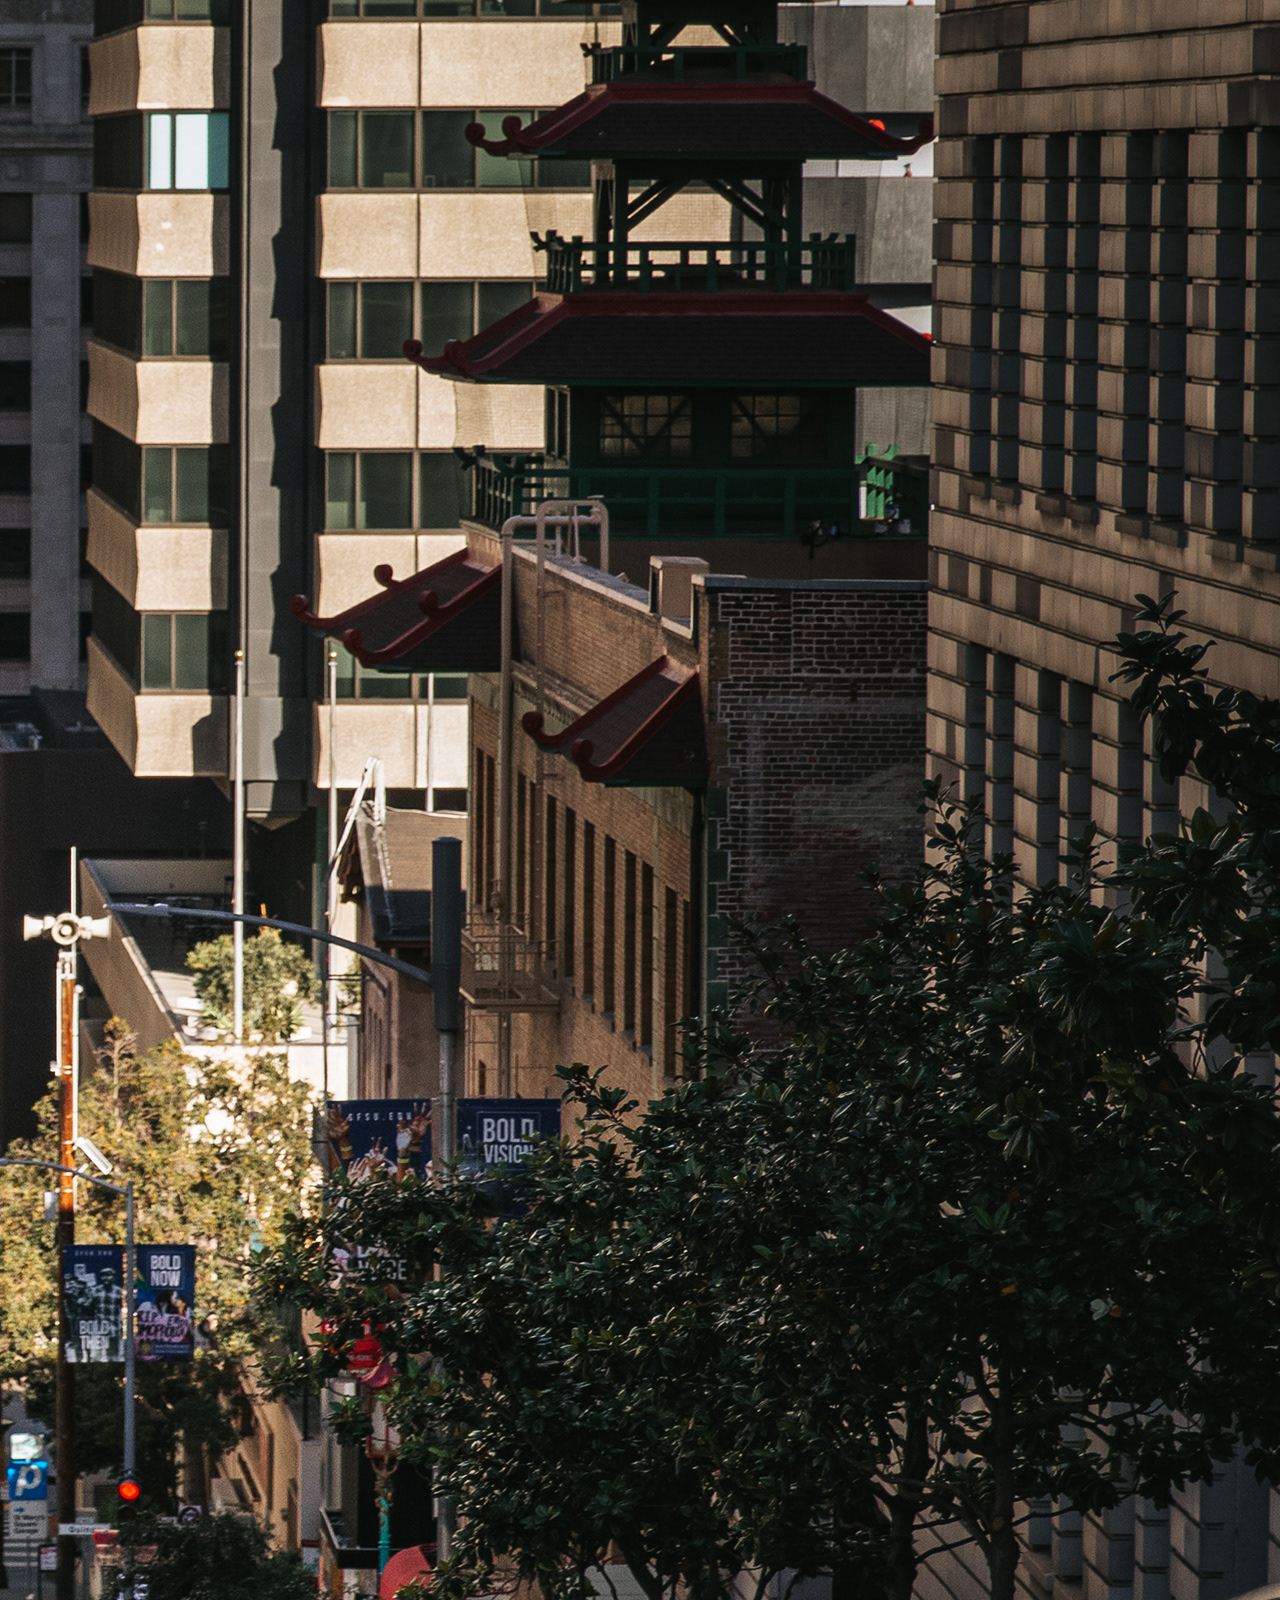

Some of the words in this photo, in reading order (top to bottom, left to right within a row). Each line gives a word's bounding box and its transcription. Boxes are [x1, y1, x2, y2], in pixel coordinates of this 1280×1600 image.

[483, 1118, 534, 1143] BOLD
[150, 1255, 181, 1270] BOLD
[150, 1270, 181, 1287] NOW
[79, 1320, 110, 1335] BOLD
